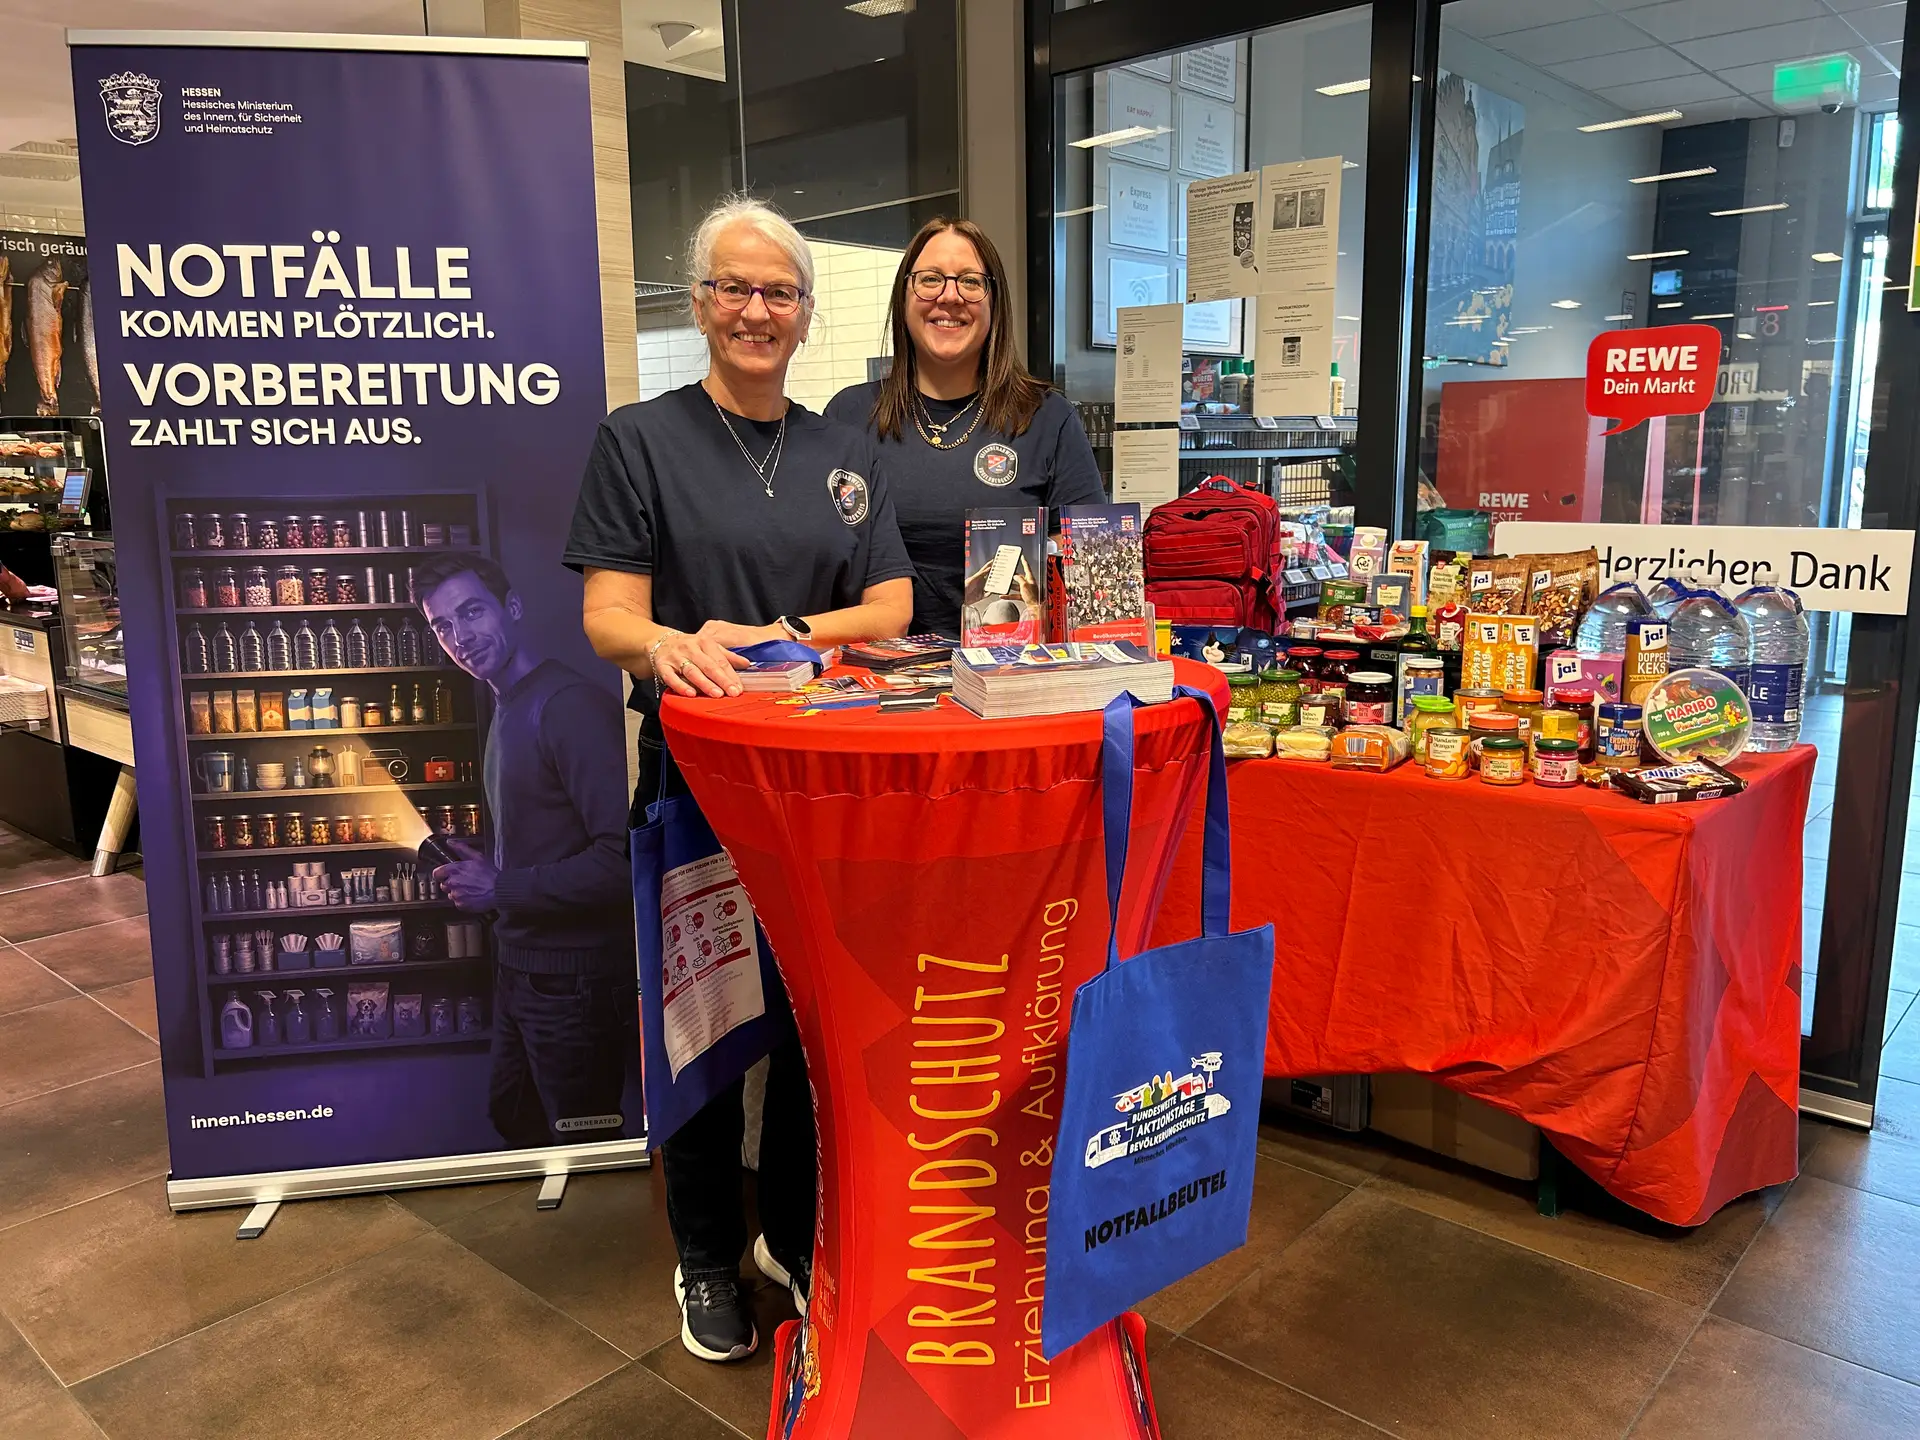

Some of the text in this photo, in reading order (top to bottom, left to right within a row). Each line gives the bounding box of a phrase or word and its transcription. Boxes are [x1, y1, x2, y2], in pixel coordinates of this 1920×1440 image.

[181, 87, 221, 97] HESSEN
[182, 100, 293, 111] Hessisches Ministerium
[183, 112, 302, 123] des Innern, für Sicherheit
[184, 124, 273, 134] und Heimatschutz
[1130, 186, 1152, 200] Express
[1132, 200, 1149, 211] Kasse
[0, 236, 35, 252] isch
[116, 230, 473, 300] NOTFÄLLE
[119, 303, 496, 340] KOMMEN PLÖTZLICH.
[1605, 345, 1699, 374] REWE
[122, 362, 561, 407] VORBEREITUNG
[1603, 376, 1696, 396] Dein Markt
[129, 417, 423, 447] ZAHLT SICH AUS.
[1478, 492, 1530, 509] REWE
[1487, 511, 1524, 525] ESTE
[1473, 574, 1489, 588] ja!
[1533, 573, 1548, 588] ja!
[1790, 551, 1892, 592] Dank
[1483, 626, 1496, 640] ja!
[1517, 628, 1531, 642] ja!
[1644, 628, 1664, 647] ja!
[1472, 650, 1481, 682] KEKSE
[1481, 653, 1491, 689] BUTTE
[1505, 652, 1515, 684] KEKSE
[1515, 655, 1526, 690] BUTTE
[1557, 662, 1577, 679] ja!
[1637, 662, 1667, 675] KEKS
[1751, 684, 1769, 700] LE
[1664, 696, 1717, 722] HARIBO
[190, 1104, 334, 1130] innen.hessen.de
[1131, 1094, 1177, 1124] BUNDESWEITE
[1136, 1100, 1196, 1138] AKTIONSTAGE
[561, 1118, 618, 1129] AI GENERATED
[1129, 1112, 1206, 1154] BEVÖLKERUNGSSCHUTZ
[906, 952, 1010, 1367] BRANDSCHUTZ
[1015, 897, 1079, 1409] Erziehung & Aufklärung
[1084, 1169, 1228, 1253] NOTFALLBEUTEL
